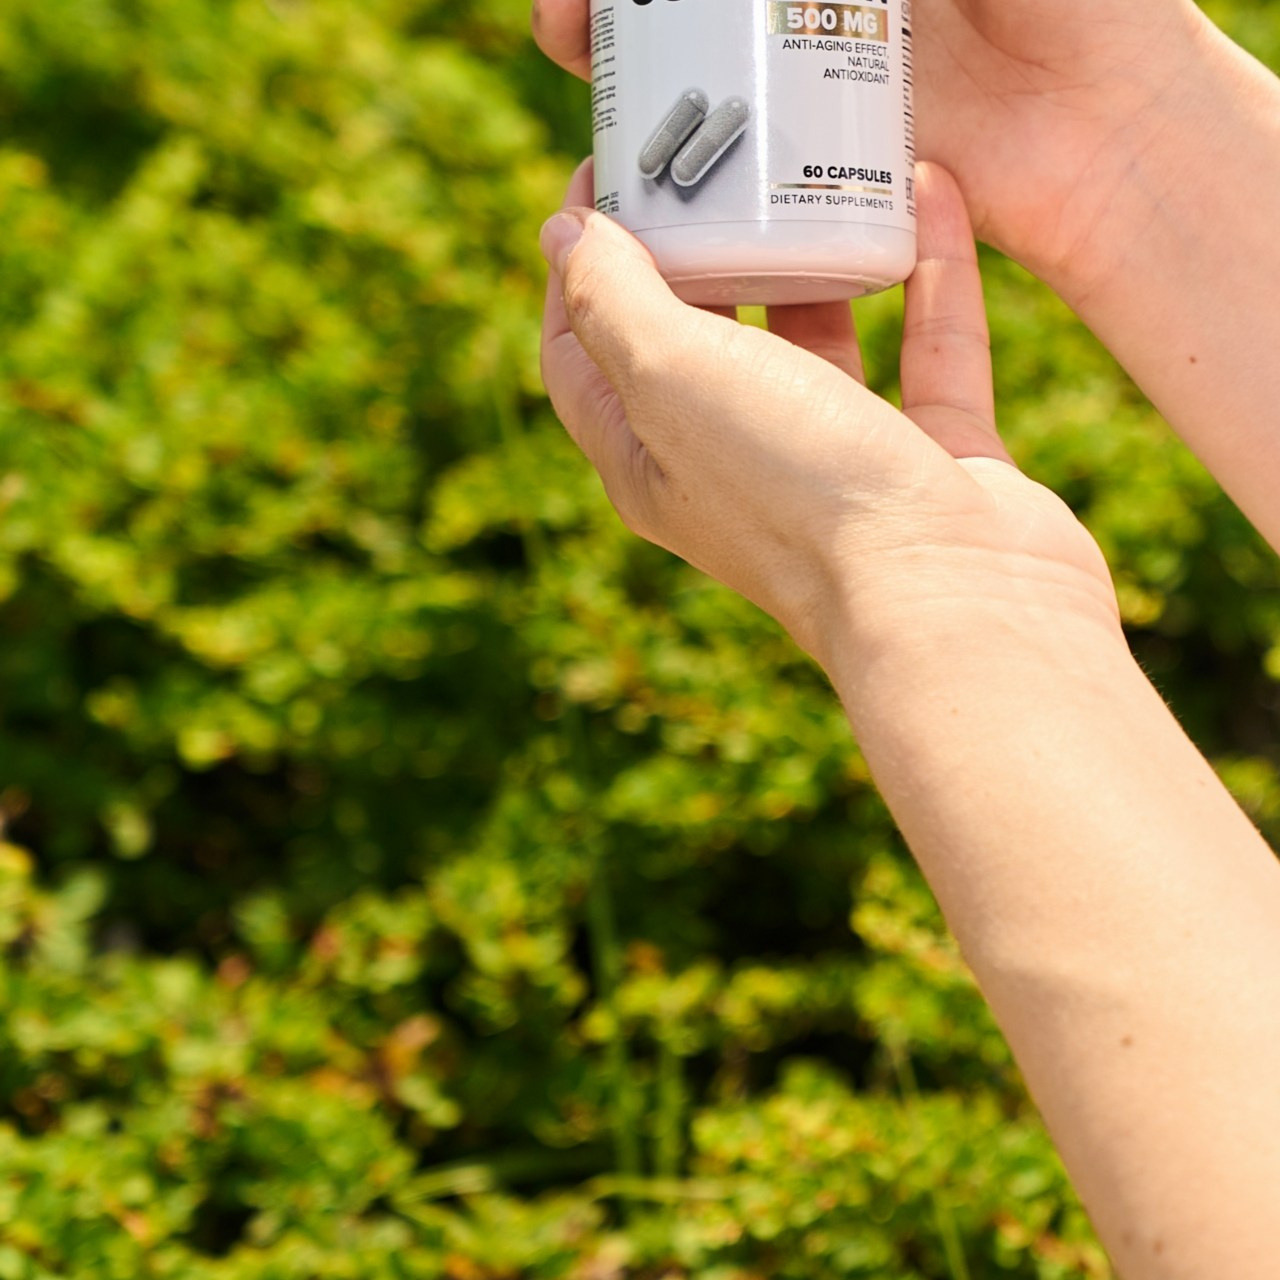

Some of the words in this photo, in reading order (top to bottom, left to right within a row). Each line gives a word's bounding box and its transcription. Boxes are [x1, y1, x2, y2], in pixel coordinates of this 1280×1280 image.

[786, 7, 838, 31] 500
[843, 10, 878, 35] MG
[782, 39, 853, 53] ANTI-AGING
[855, 42, 889, 59] EFFECT,
[847, 56, 890, 72] NATURAL
[823, 68, 890, 85] ANTIOXIDANT
[803, 165, 823, 179] 60
[827, 166, 892, 184] CAPSULES
[770, 194, 822, 205] DIETARY
[825, 194, 894, 211] SUPPLEMENTS
